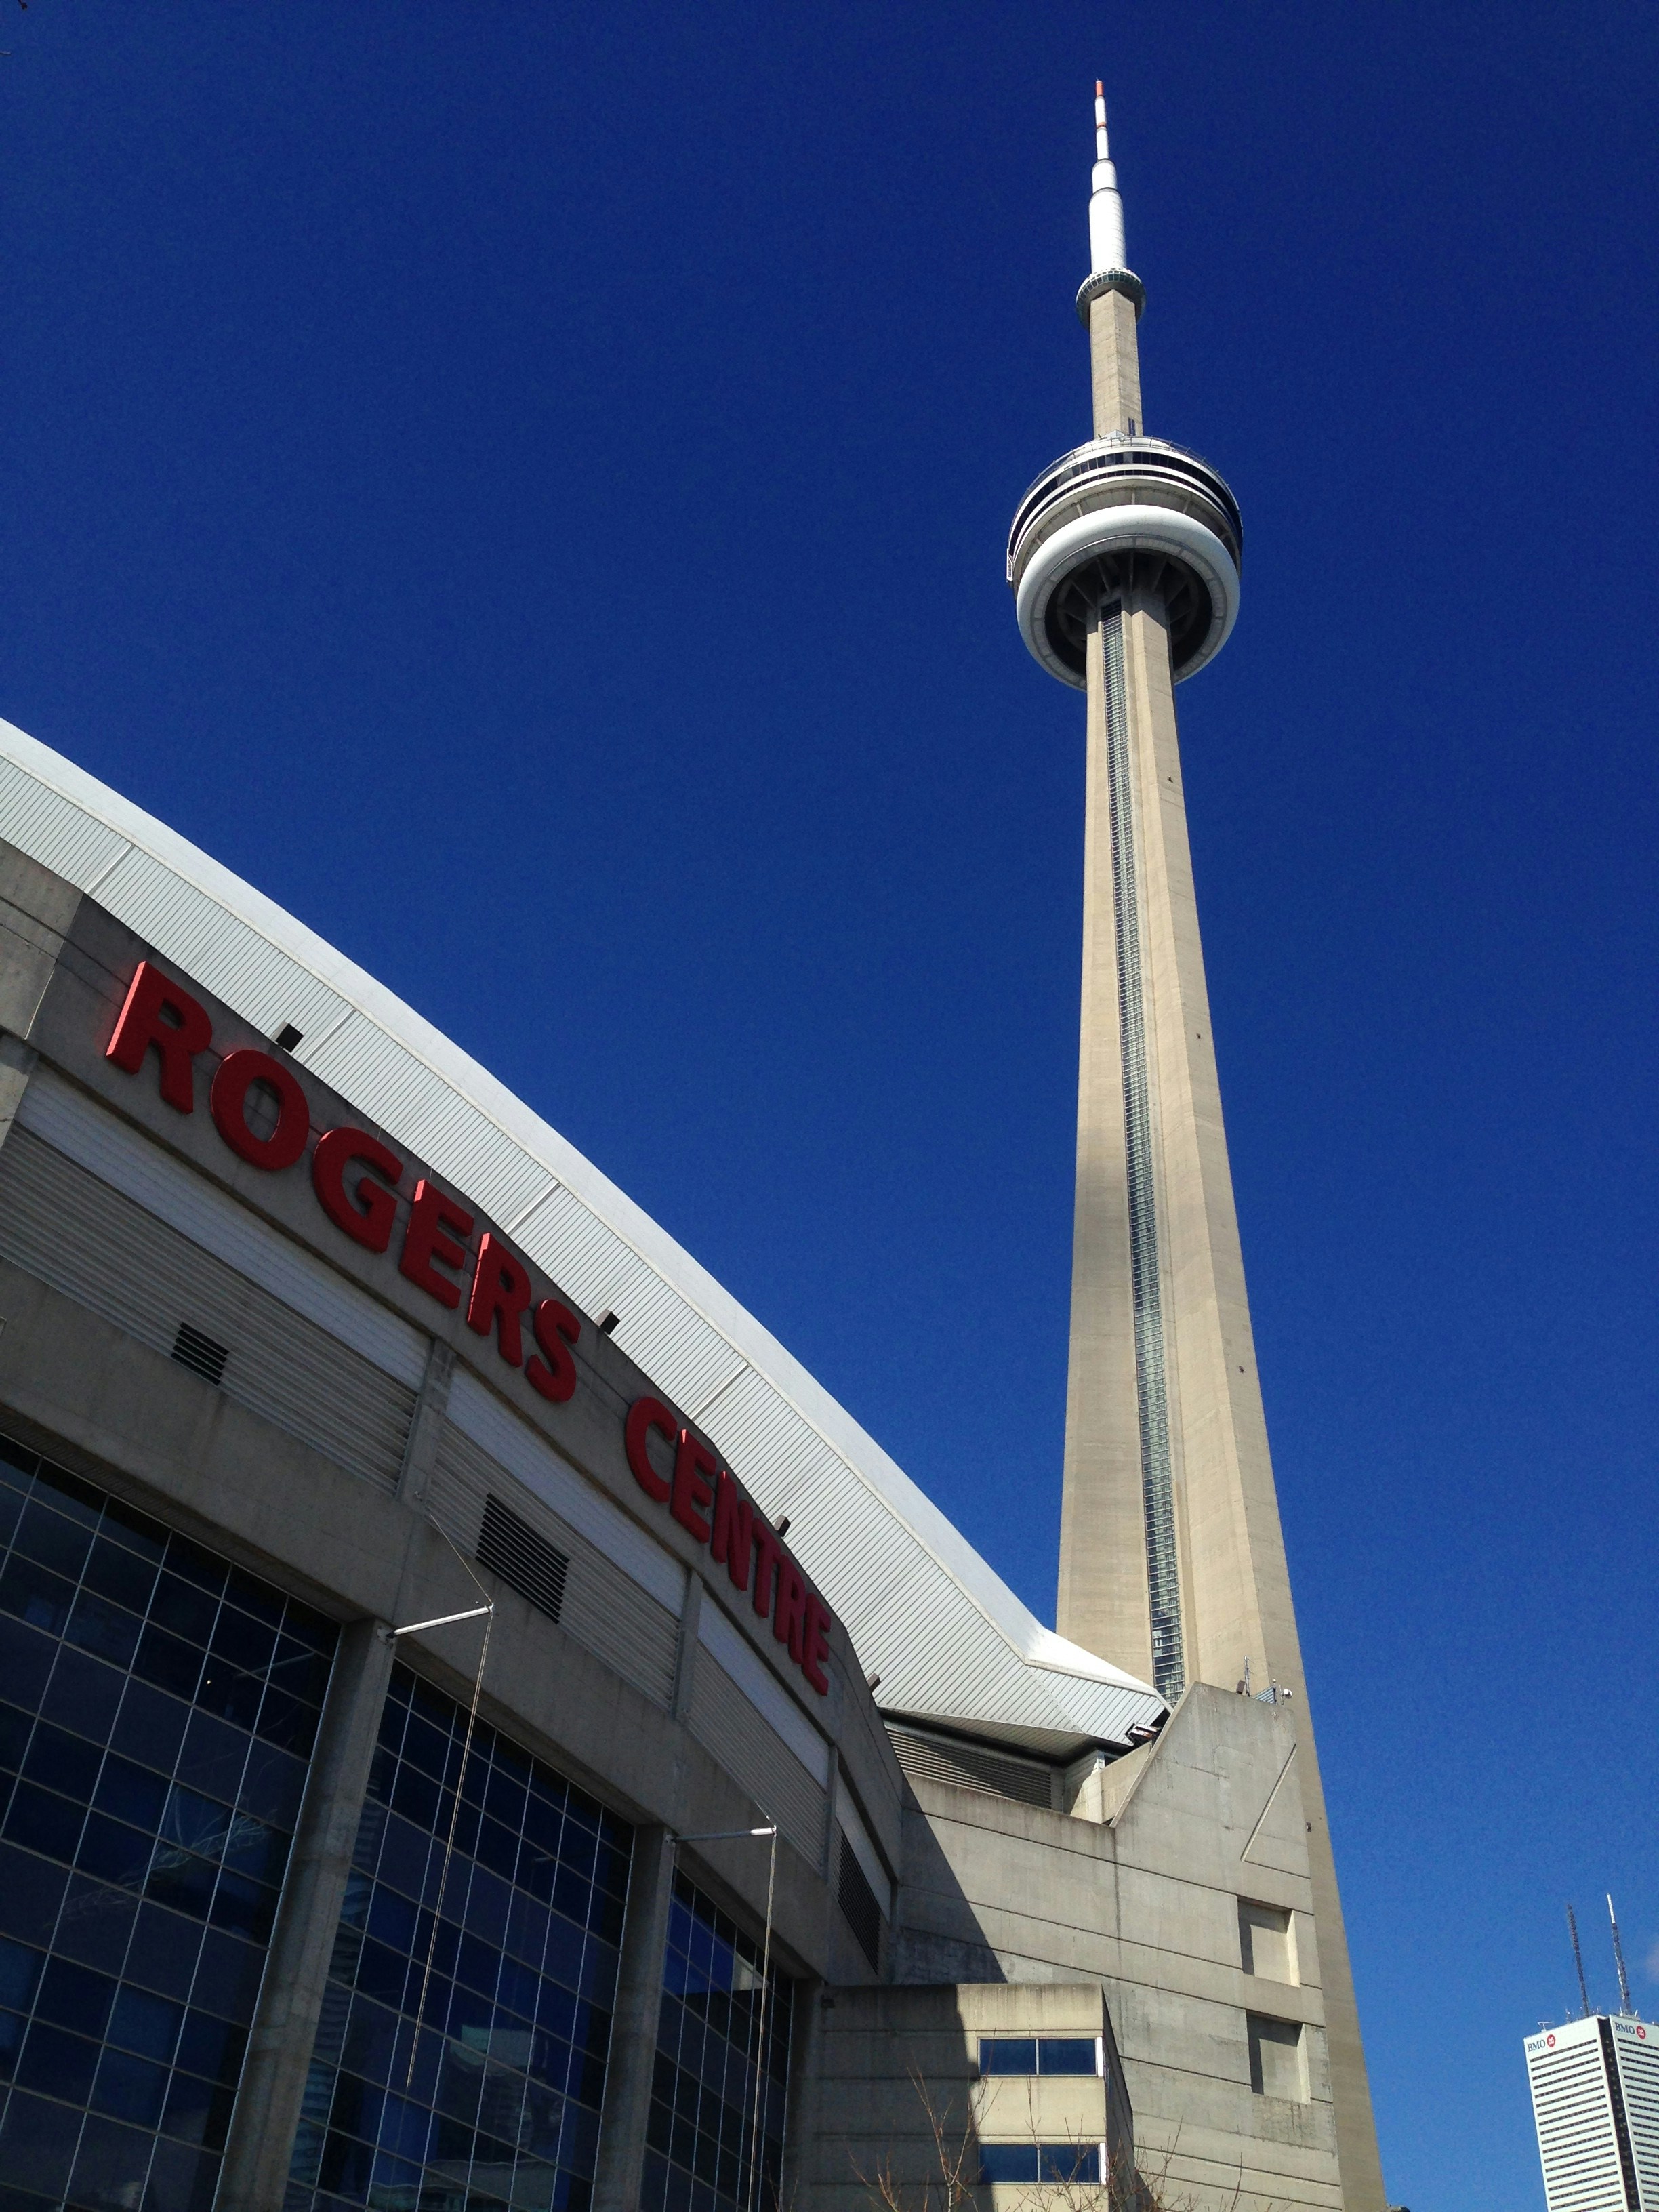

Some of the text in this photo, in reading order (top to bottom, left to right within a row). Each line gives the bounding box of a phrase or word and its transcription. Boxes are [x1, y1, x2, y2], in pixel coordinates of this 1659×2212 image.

[106, 960, 832, 1696] ROGERS CENTRE
[1615, 2022, 1635, 2035] BMO
[1527, 2039, 1546, 2053] BMO
